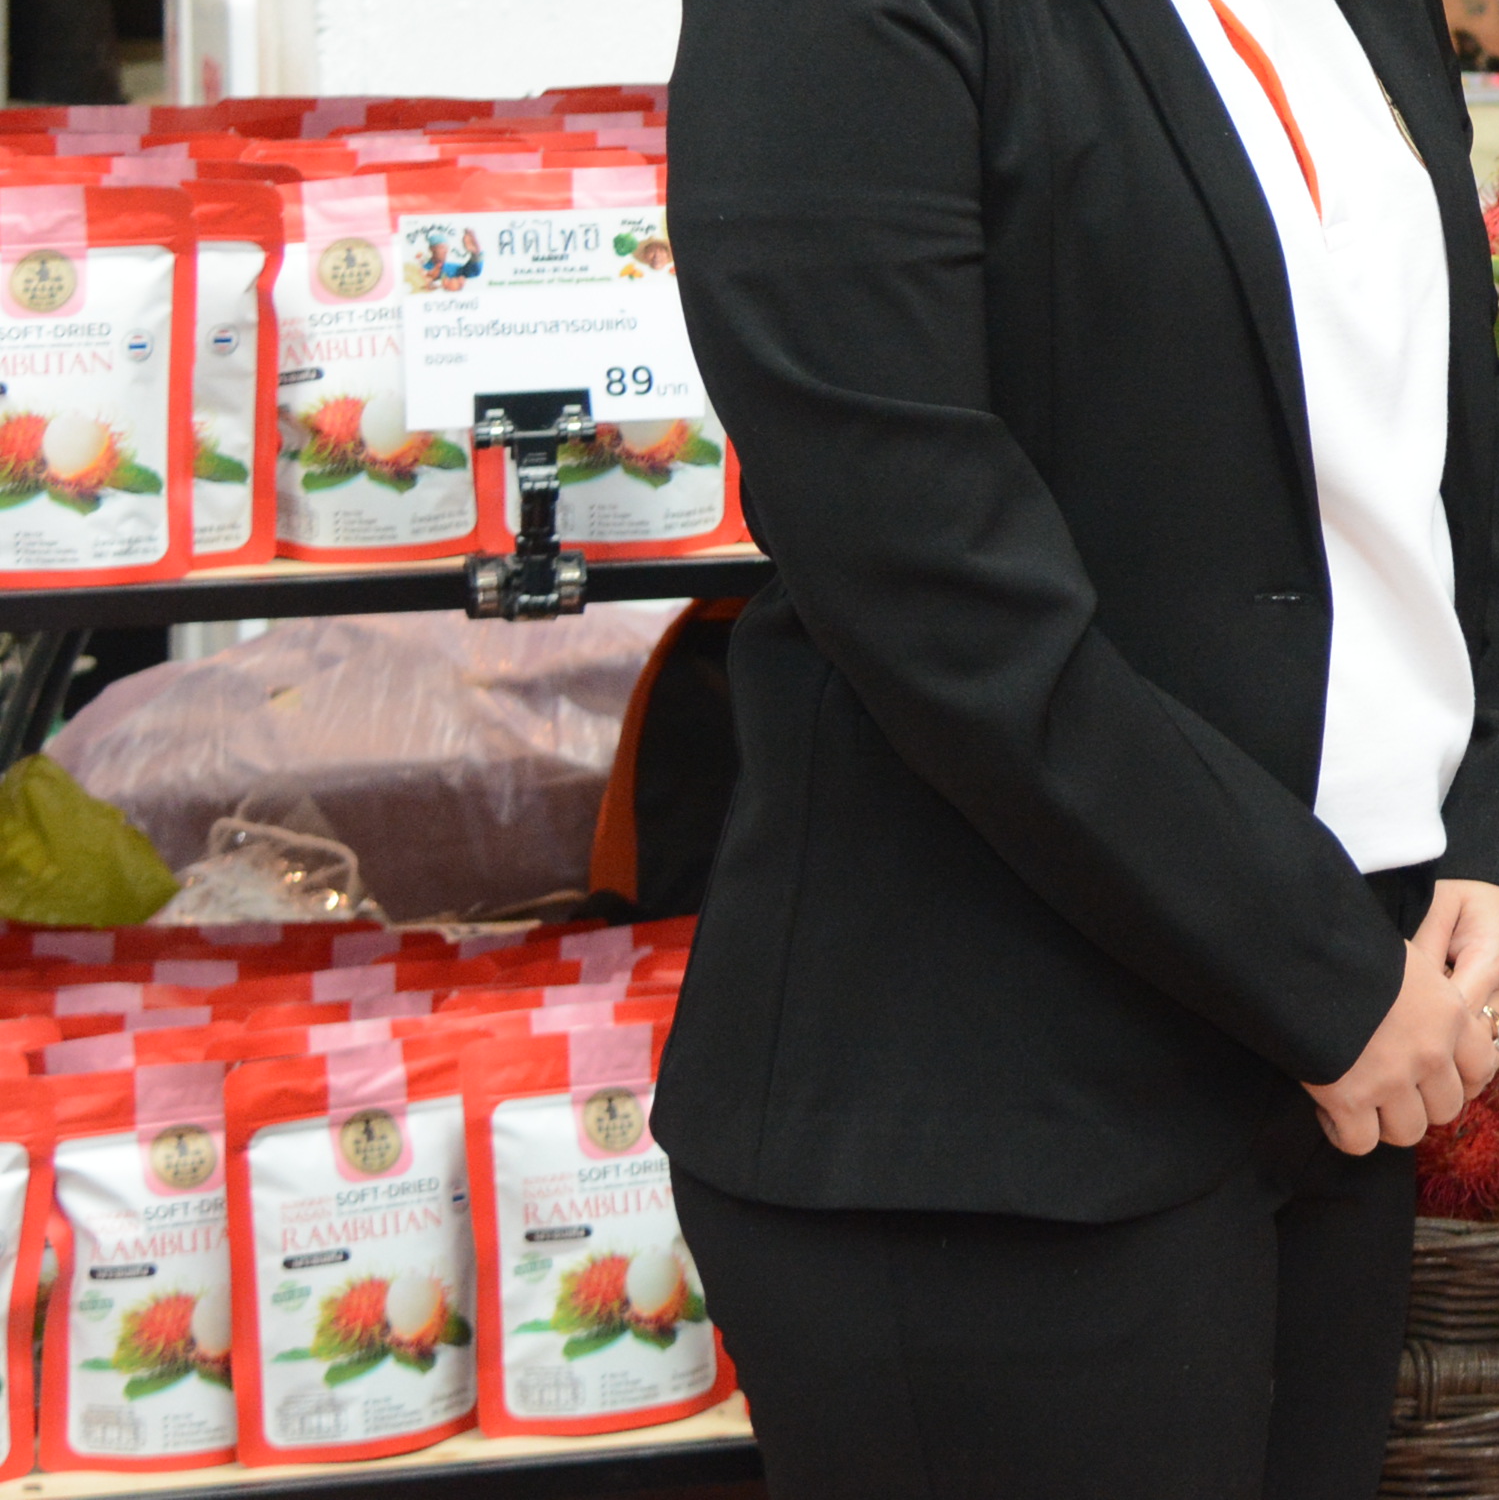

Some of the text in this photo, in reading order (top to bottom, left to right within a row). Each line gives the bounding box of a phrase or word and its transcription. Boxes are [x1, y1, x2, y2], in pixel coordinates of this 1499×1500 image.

[605, 365, 689, 397] 89 บาท
[336, 1177, 441, 1206] SOFT-DRIED
[282, 1202, 443, 1253] RAMBUTAN
